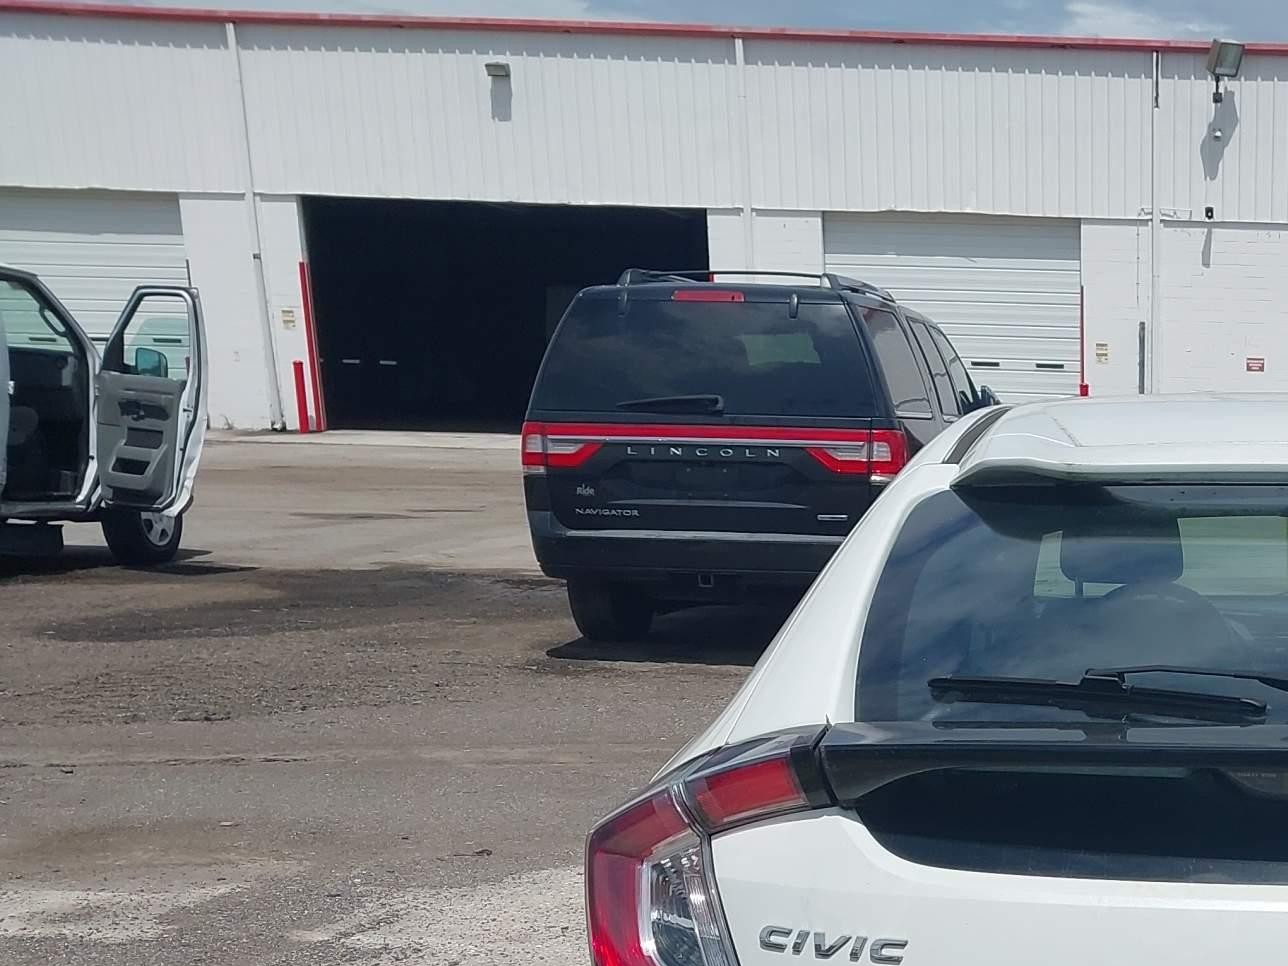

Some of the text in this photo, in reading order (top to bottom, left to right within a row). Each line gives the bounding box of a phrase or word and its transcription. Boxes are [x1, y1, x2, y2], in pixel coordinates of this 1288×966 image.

[627, 446, 780, 457] LINCOLN
[575, 508, 640, 516] NAVIGATOR
[759, 925, 908, 966] CIVIC
